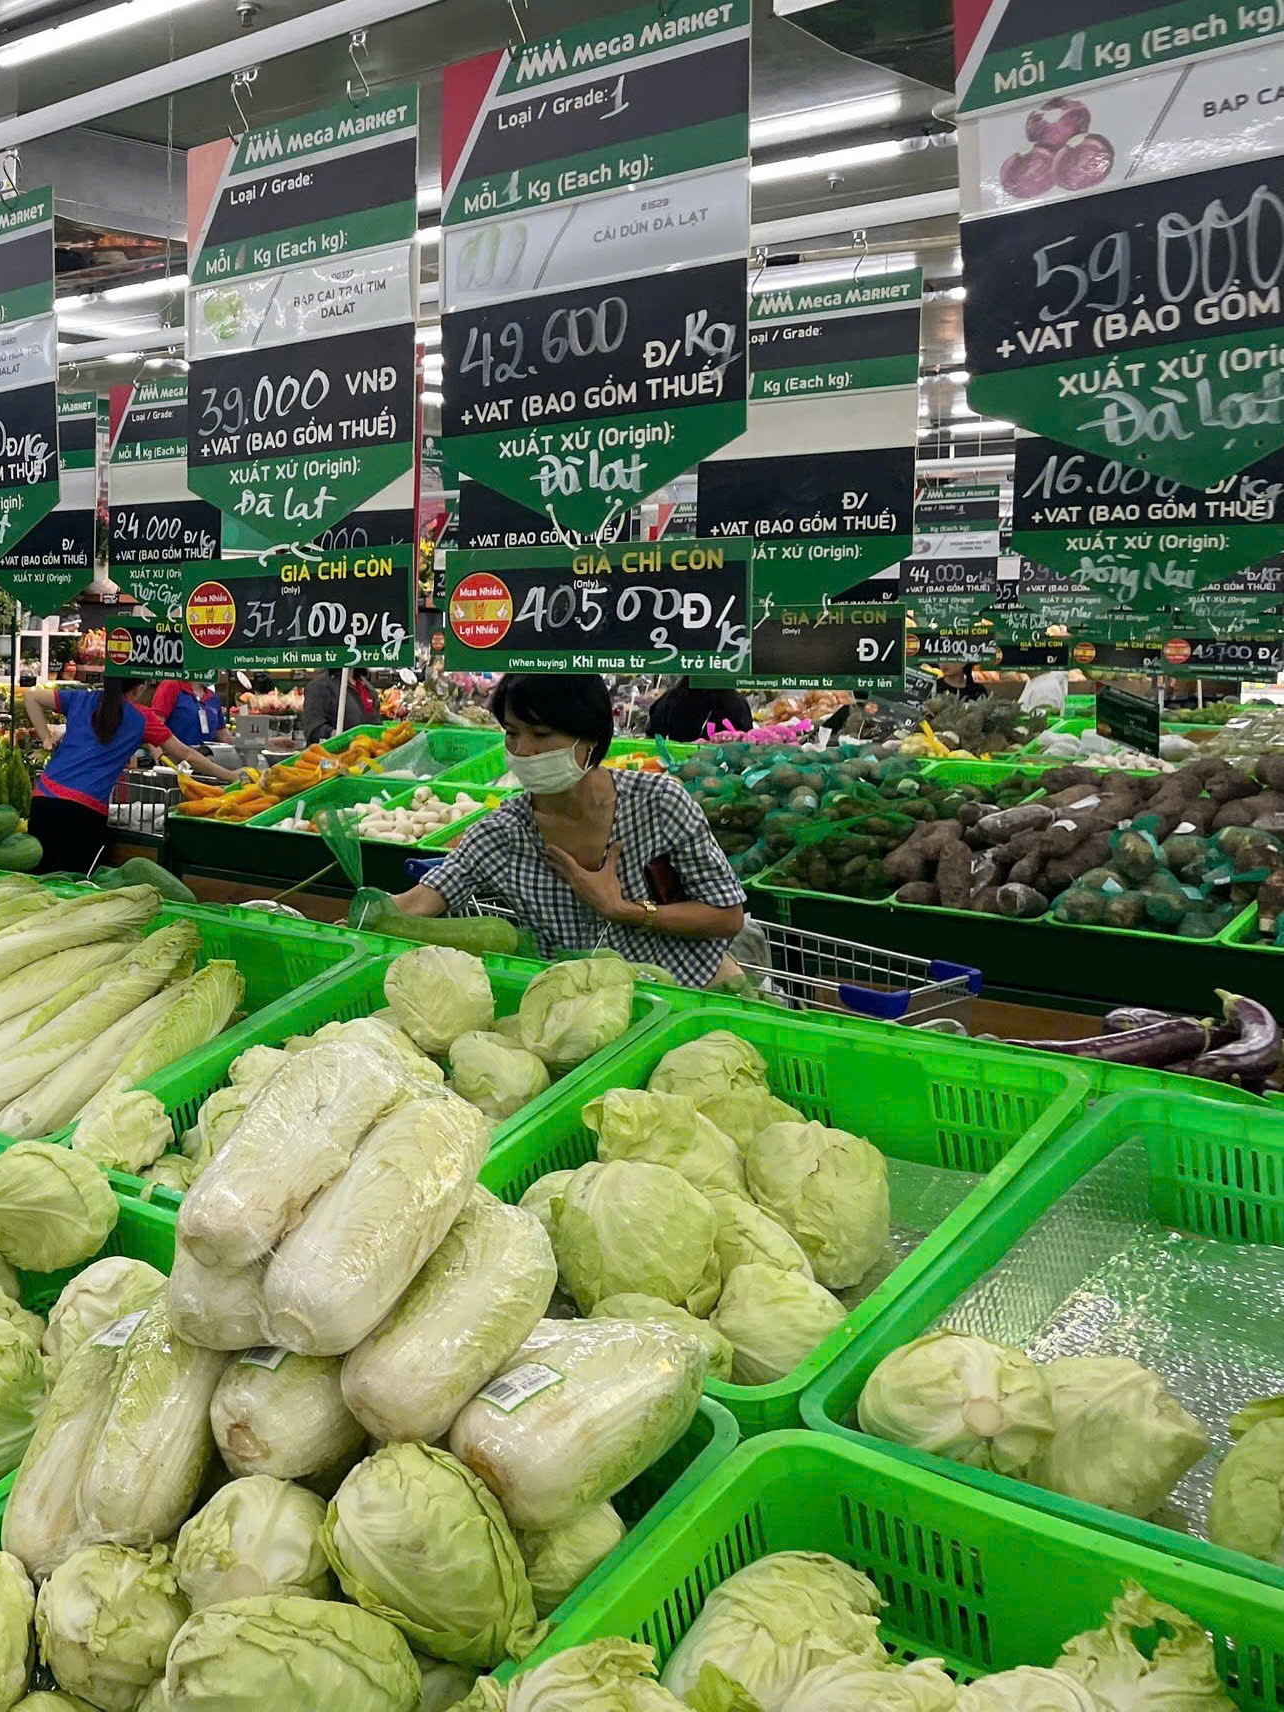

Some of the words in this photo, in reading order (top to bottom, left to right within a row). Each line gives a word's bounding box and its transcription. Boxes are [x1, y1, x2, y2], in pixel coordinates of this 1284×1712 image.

[994, 51, 1045, 93] MỖI
[1094, 41, 1130, 69] Kg
[1142, 13, 1226, 59] (Each
[498, 106, 531, 130] Loại
[552, 89, 608, 115] Grade:
[230, 186, 256, 205] Loại
[272, 173, 314, 195] Grade:
[465, 182, 496, 215] MỖI
[528, 179, 550, 201] Kg
[557, 164, 612, 195] (Each
[619, 154, 654, 182] kg):
[206, 248, 230, 276] MỖI
[254, 247, 271, 266] Kg
[276, 235, 316, 262] (Each
[321, 230, 348, 250] kg):
[321, 302, 355, 318] DALAT
[996, 320, 1079, 358] +VAT
[1194, 278, 1280, 325] GỒM
[460, 297, 628, 387] 42.600
[1059, 355, 1145, 398] XUẤT
[1158, 349, 1207, 383] XỨ
[197, 368, 330, 436] 39.000
[345, 366, 397, 395] VNĐ
[461, 398, 513, 425] +VAT
[522, 390, 576, 421] (BAO
[584, 374, 636, 409] GỒM
[645, 359, 723, 400] THUẾ)
[201, 435, 240, 457] +VAT
[246, 430, 287, 455] (BAO
[292, 416, 333, 446] GỒM
[339, 405, 397, 440] THUẾ)
[499, 427, 553, 459] XUẤT
[560, 426, 591, 451] XỨ
[599, 421, 675, 451] (Origin):
[229, 459, 271, 485] XUẤT
[275, 459, 298, 479] XỨ
[303, 456, 361, 481] (Origin):
[1032, 507, 1082, 523] +VAT
[1089, 504, 1140, 525] (BAO
[1148, 495, 1196, 519] GỒM
[1205, 493, 1275, 520] THUẾ)
[114, 512, 181, 541] 24.000
[1066, 530, 1118, 552] XUẤT
[1124, 532, 1152, 549] XỨ
[1159, 535, 1230, 552] (Origin):
[281, 563, 309, 583] GIÁ
[317, 559, 346, 579] CHỈ
[354, 555, 393, 577] CÒN
[572, 552, 611, 575] GIÁ
[621, 550, 661, 573] CHỈ
[670, 545, 724, 571] CÒN
[281, 586, 301, 595] (Only)
[459, 588, 477, 597] Mua
[479, 586, 503, 597] Nhiều
[573, 579, 599, 590] (Only)
[459, 626, 474, 635] Lợi
[476, 625, 499, 635] Nhiều
[509, 658, 535, 668] (When
[537, 658, 567, 669] buying)
[572, 655, 593, 668] Khi
[597, 658, 625, 668] mua
[630, 654, 645, 668] từ
[680, 654, 704, 668] trở
